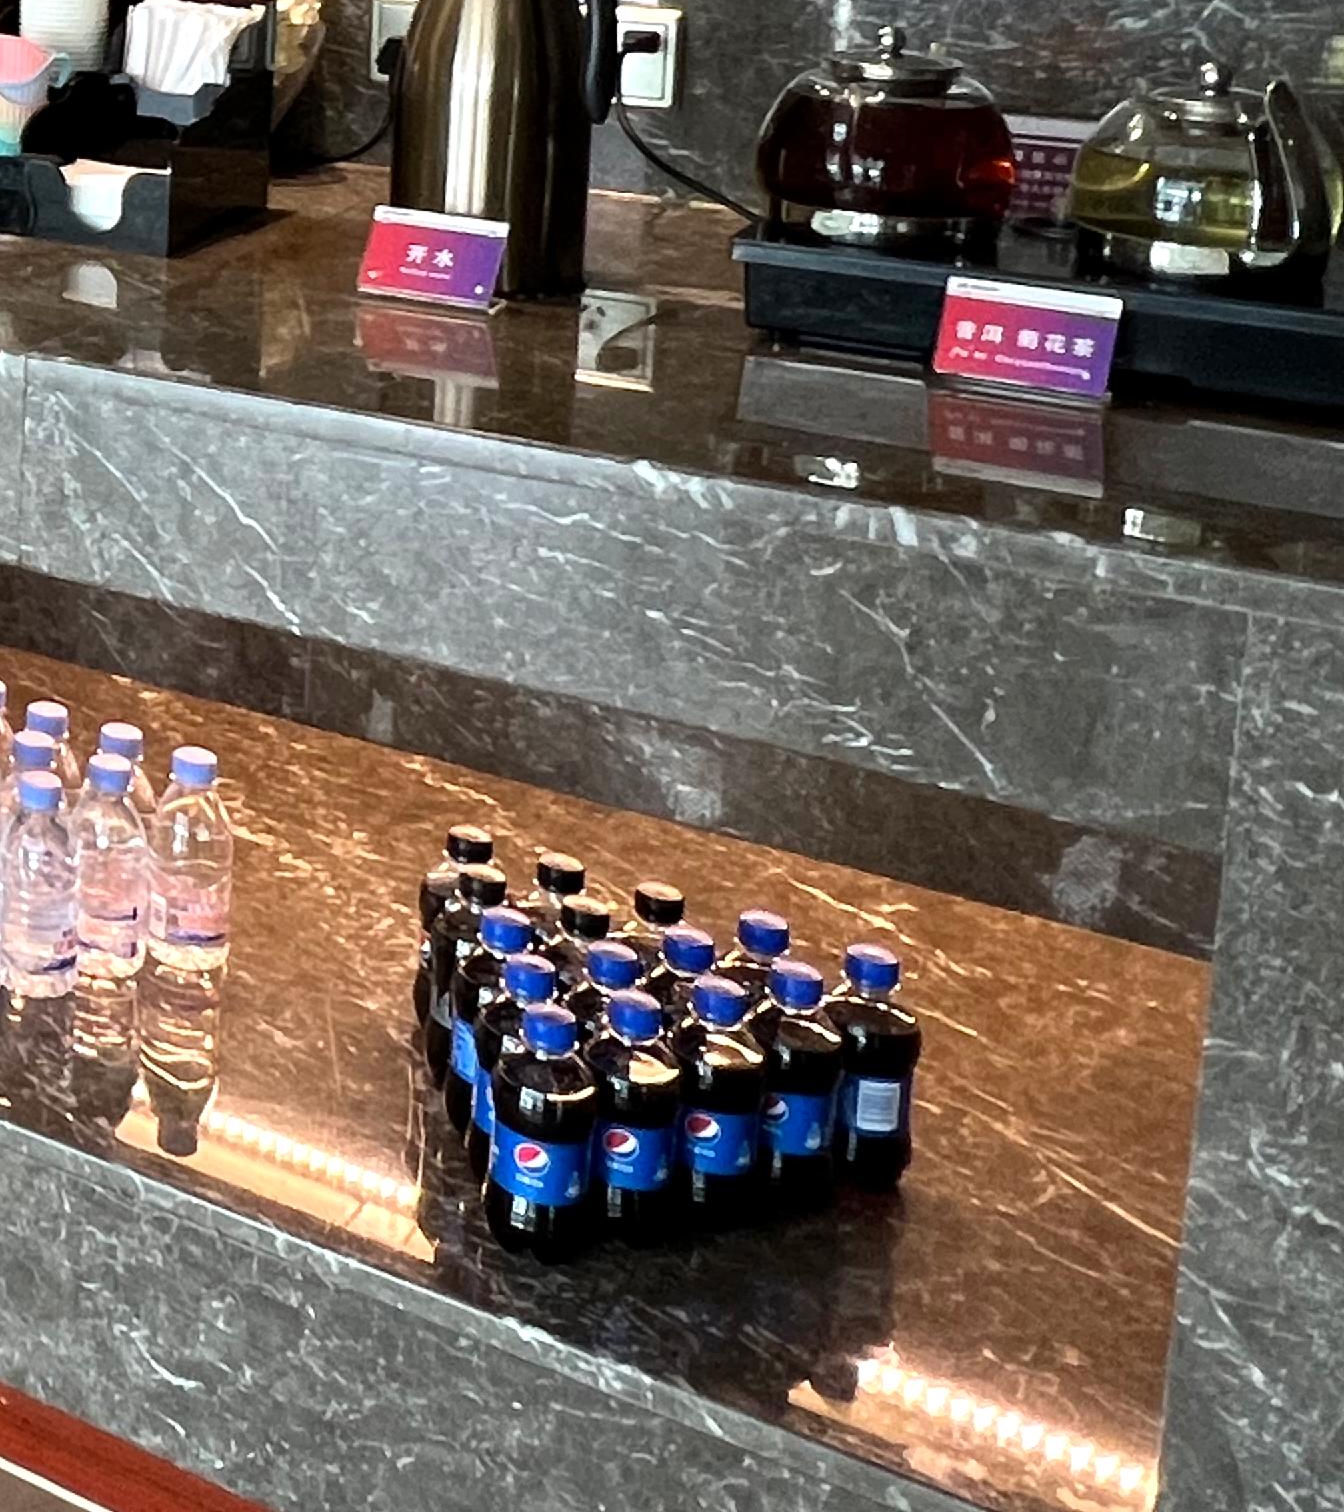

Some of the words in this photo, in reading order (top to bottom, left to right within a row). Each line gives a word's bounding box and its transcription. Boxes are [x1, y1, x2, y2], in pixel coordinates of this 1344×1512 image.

[404, 244, 455, 268] 开水
[955, 320, 1004, 345] 普洱
[1016, 329, 1096, 358] 菊花茶
